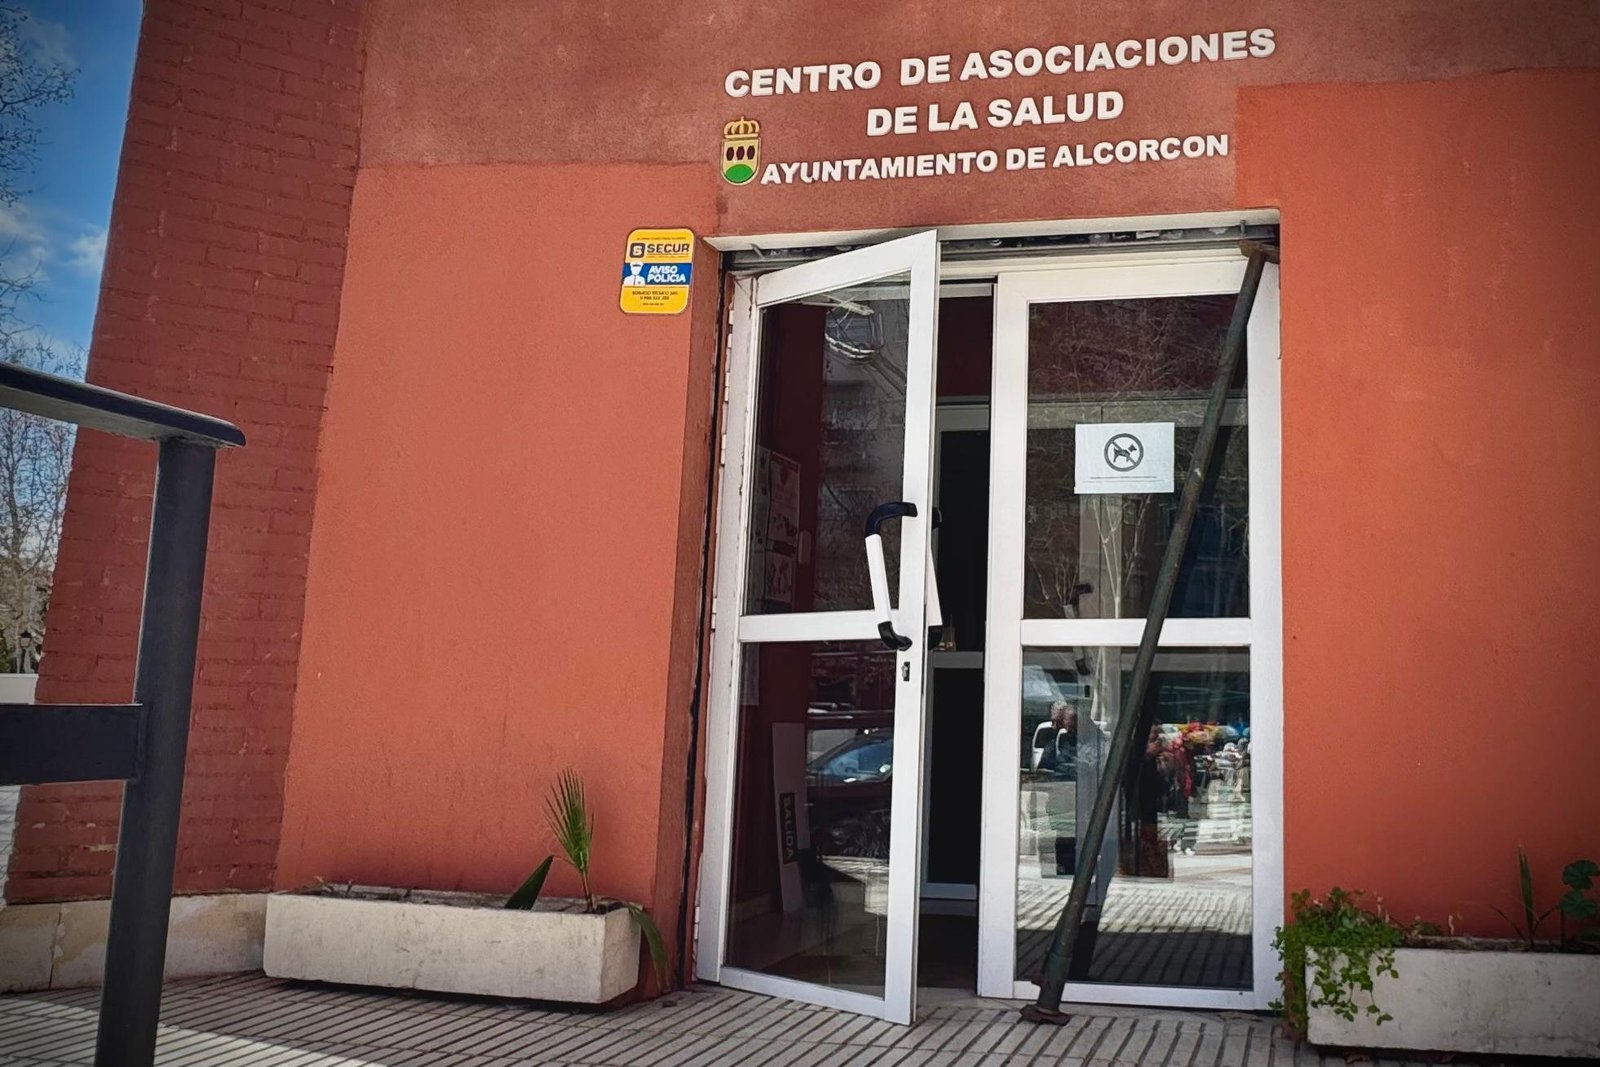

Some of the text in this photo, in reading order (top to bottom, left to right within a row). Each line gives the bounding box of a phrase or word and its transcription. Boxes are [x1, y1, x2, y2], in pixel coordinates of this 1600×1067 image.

[724, 28, 1277, 98] CENTRO DE ASOCIACIONES
[866, 91, 1125, 137] DE LA SALUD
[760, 134, 1229, 185] AYUNTAMIENTO DE ALCORCON
[646, 243, 690, 253] SECUR
[647, 273, 687, 283] POLICIA
[649, 265, 678, 274] AVISO
